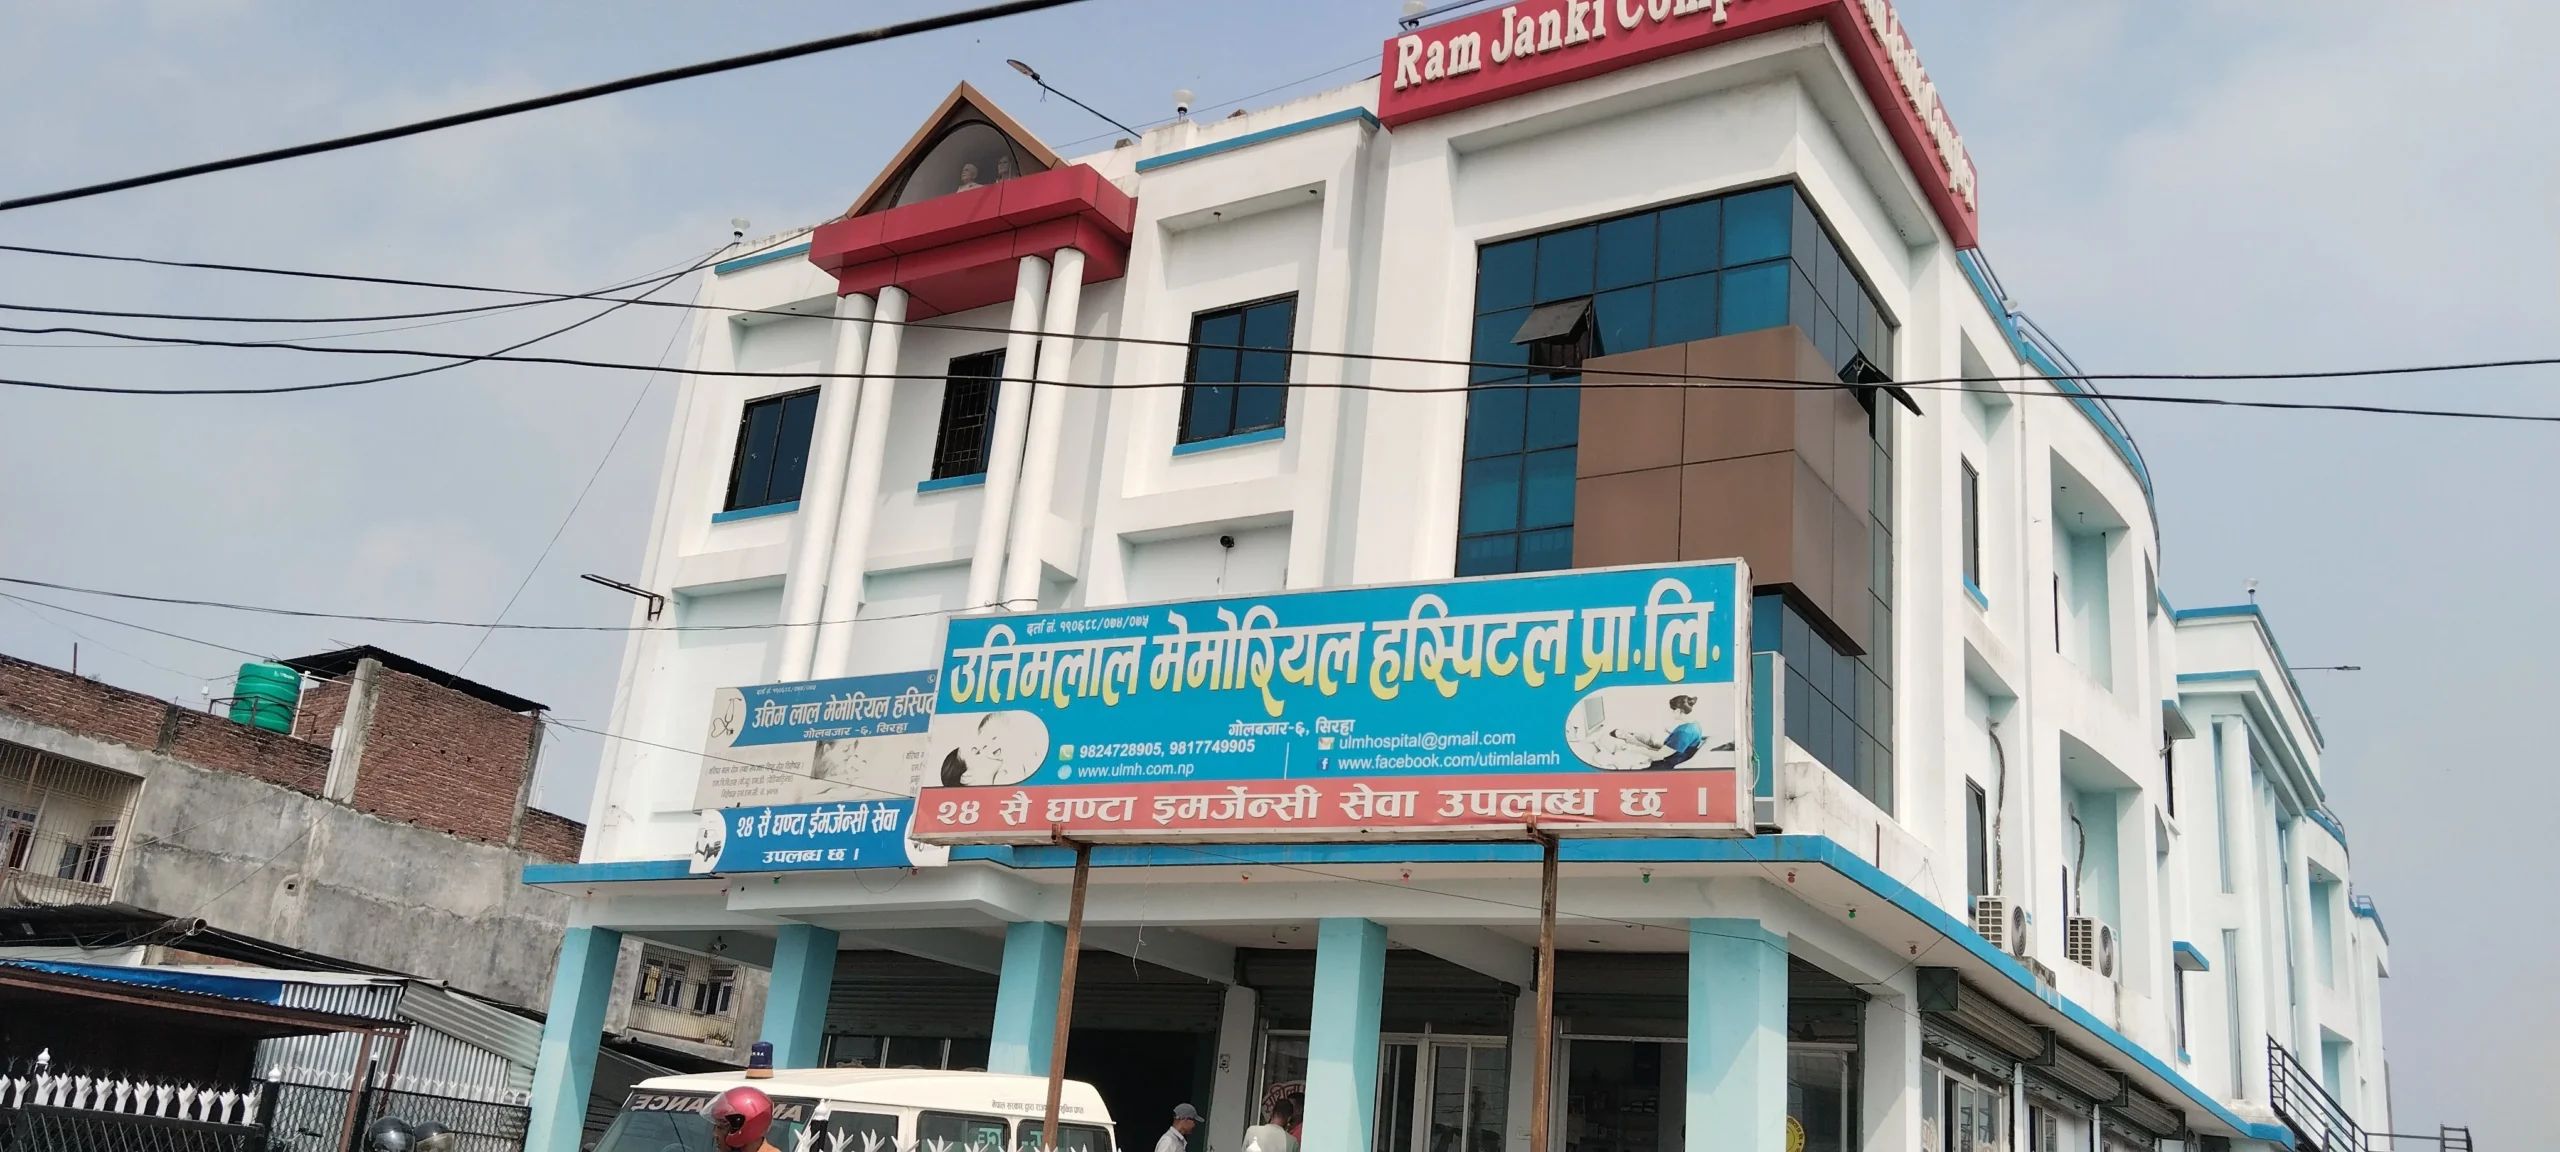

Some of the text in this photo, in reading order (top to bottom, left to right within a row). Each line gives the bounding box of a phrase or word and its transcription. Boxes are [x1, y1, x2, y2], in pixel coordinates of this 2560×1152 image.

[1393, 30, 1482, 91] Ram
[1491, 0, 1606, 64] Janki
[1027, 618, 1046, 636] दर्ता
[950, 623, 1148, 709] उत्तिमलाल
[1150, 604, 1365, 717] मेमोरियल
[1368, 592, 1574, 701] हस्पिटल
[752, 699, 788, 729] उत्तिम
[789, 701, 823, 726] लाल
[824, 691, 892, 722] मेमोरियल
[876, 722, 909, 733] सिरहा
[1315, 716, 1356, 735] सिरहा
[1079, 739, 1256, 759] 9824728905, 9817749905
[1339, 730, 1516, 752] ulmhospital@gmail.com
[1078, 761, 1194, 778] www.ulmh.com.np
[1338, 749, 1560, 770] www.facebook.com/utimlalamh
[936, 800, 980, 826] २४
[999, 790, 1033, 826] सै
[1045, 795, 1138, 824] घण्टा
[1151, 784, 1323, 826] इमर्जेन्सी
[1338, 782, 1420, 820] सेवा
[1437, 787, 1600, 818] उपलब्ध
[1618, 787, 1669, 818] छ
[736, 815, 754, 838] २४
[757, 807, 772, 838] सै
[772, 813, 807, 836] घण्टा
[872, 802, 900, 834] सेवा
[762, 849, 824, 864] उपलब्ध
[828, 848, 847, 862] छ
